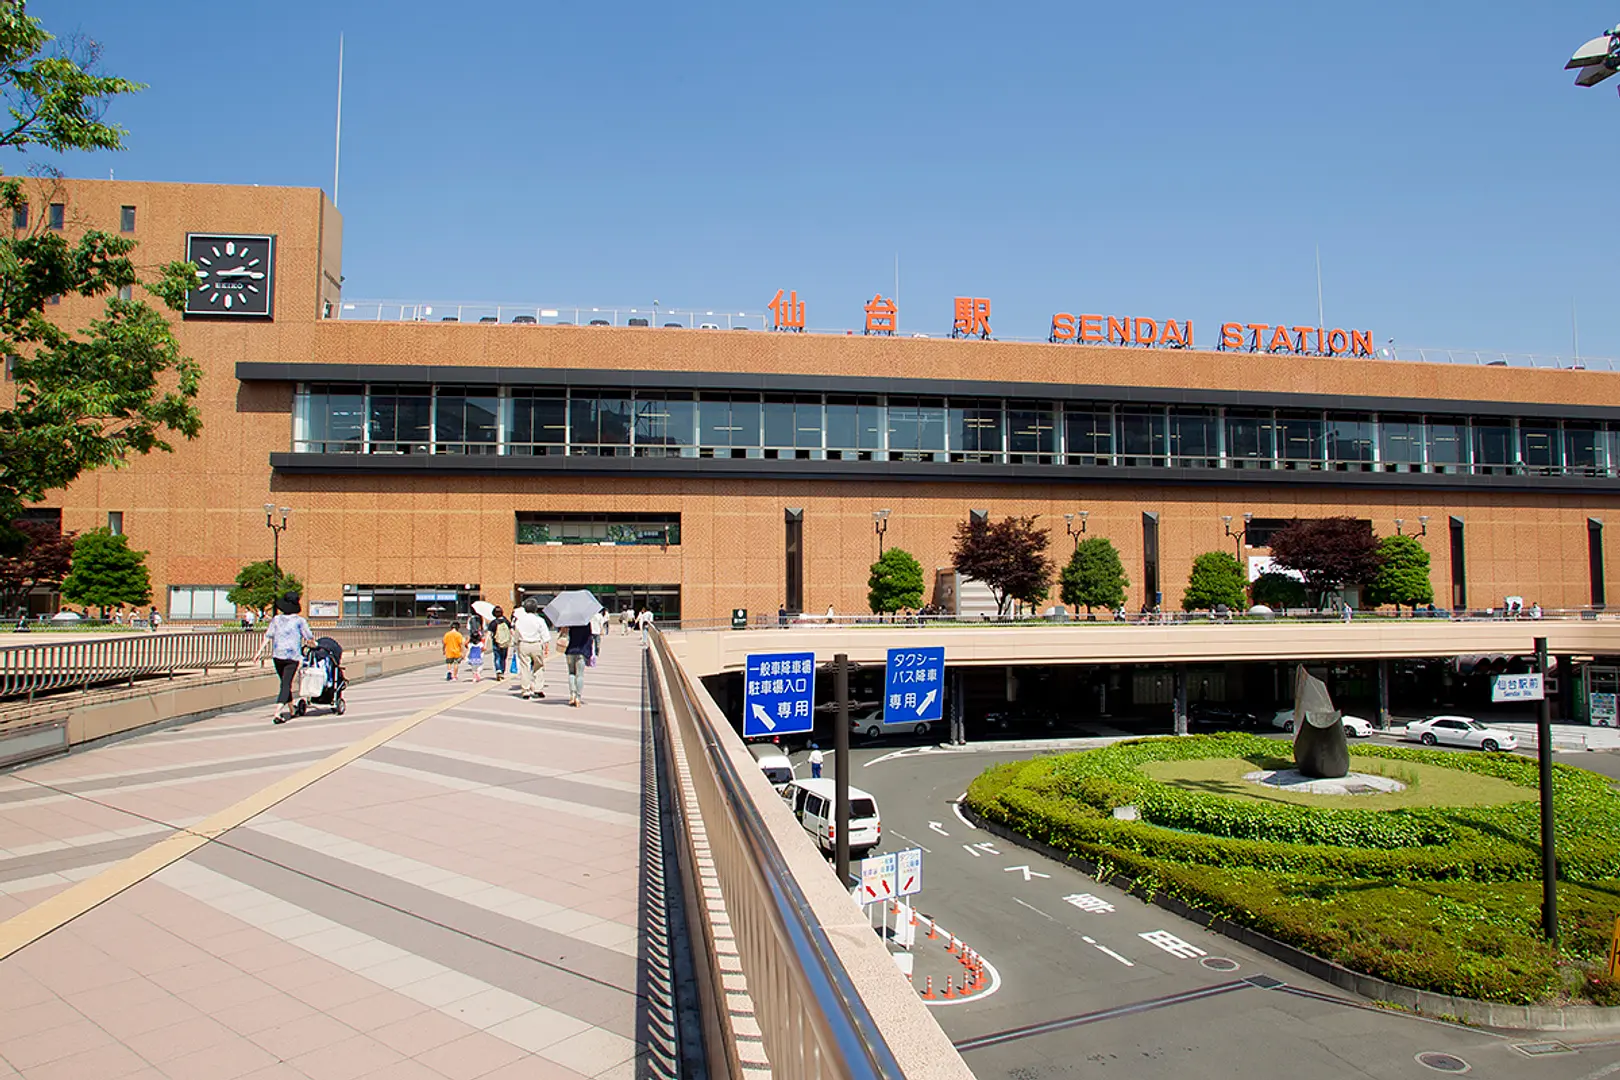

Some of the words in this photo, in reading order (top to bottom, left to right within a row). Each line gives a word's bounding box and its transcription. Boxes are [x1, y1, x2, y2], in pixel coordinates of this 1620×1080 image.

[768, 289, 993, 334] 仙台駅
[1052, 313, 1193, 346] SENDAI
[1222, 323, 1373, 354] STATION
[749, 660, 811, 677] 一般車降車場
[894, 653, 938, 667] タクシー
[892, 669, 938, 684] バス降車
[748, 678, 807, 695] 駐車場入口
[777, 700, 809, 718] 専用
[889, 693, 917, 710] 専用
